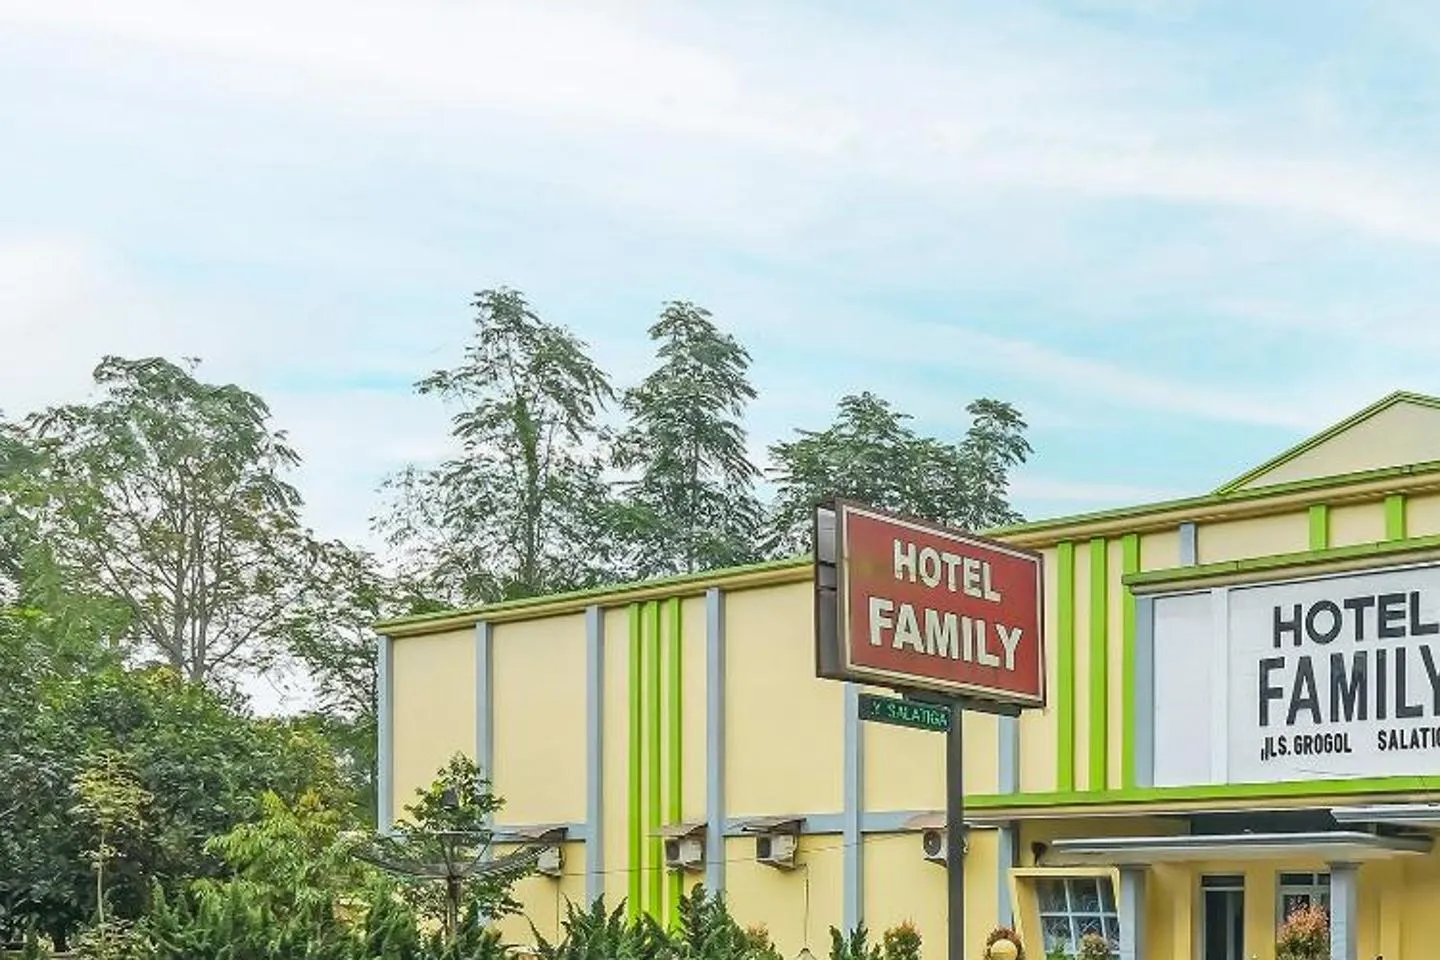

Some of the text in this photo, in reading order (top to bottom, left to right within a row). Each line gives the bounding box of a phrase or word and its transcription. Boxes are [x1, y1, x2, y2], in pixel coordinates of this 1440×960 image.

[893, 538, 1002, 603] HOTEL
[868, 596, 1022, 671] FAMILY
[1273, 591, 1440, 648] HOTEL
